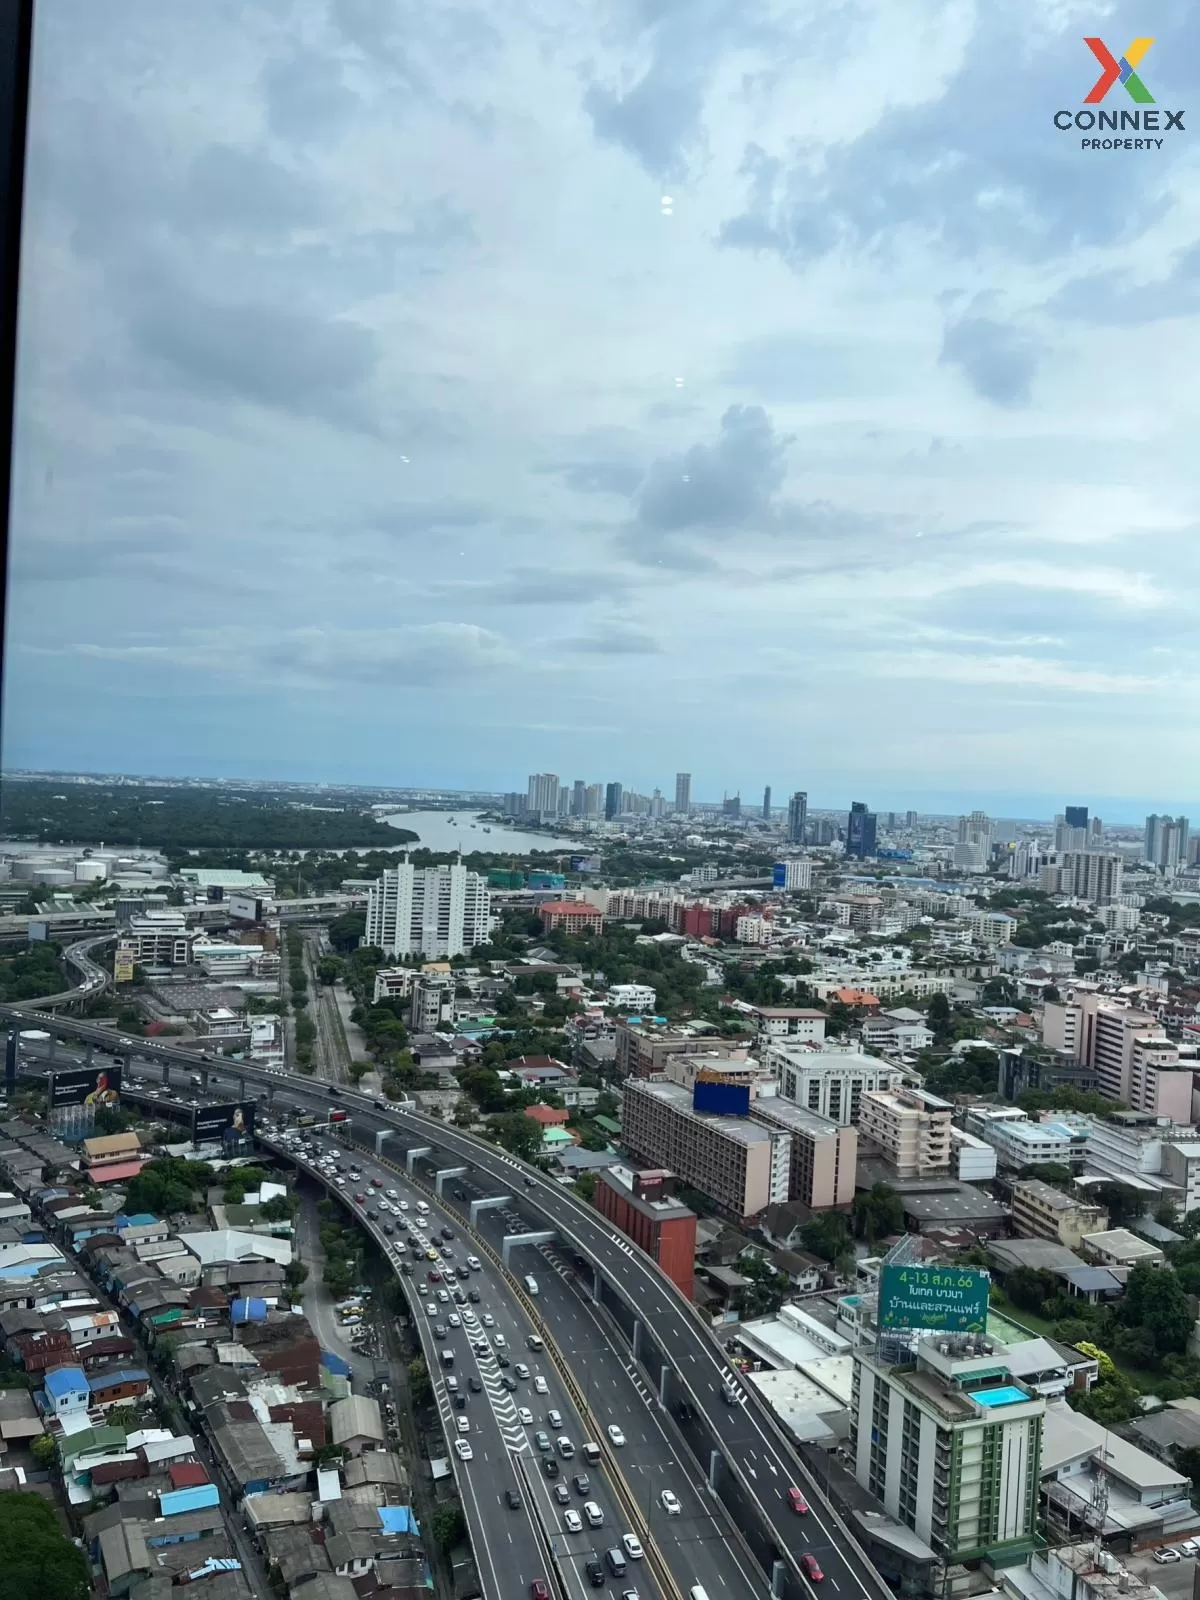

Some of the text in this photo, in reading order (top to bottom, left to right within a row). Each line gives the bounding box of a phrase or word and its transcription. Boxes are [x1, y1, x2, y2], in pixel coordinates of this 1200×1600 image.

[899, 1271, 973, 1288] 4-13 ส.ค. 66
[908, 1284, 963, 1299] ไบเทค บางนา
[889, 1295, 981, 1315] บ้านและสวนแฟร์
